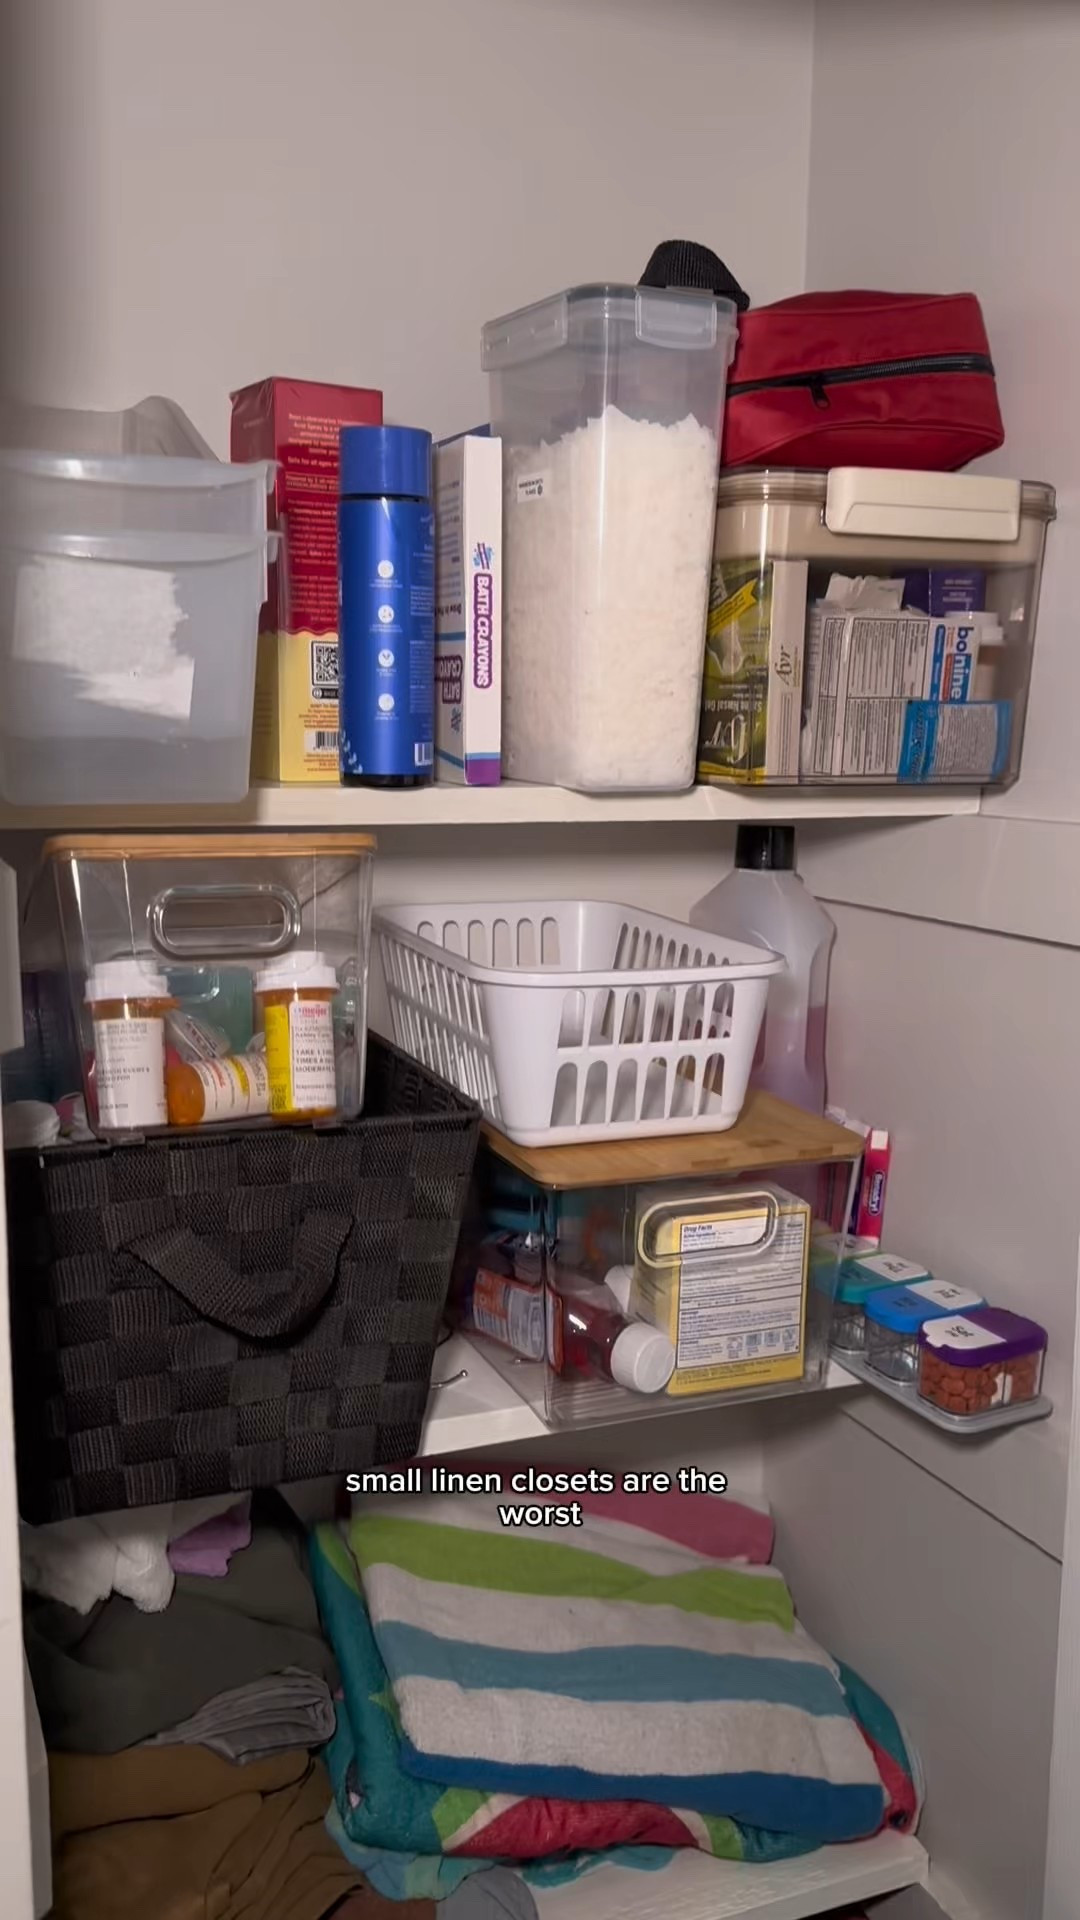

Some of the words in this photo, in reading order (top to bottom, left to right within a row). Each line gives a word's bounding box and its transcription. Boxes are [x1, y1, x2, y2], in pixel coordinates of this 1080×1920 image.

[476, 575, 490, 615] BATH
[475, 616, 489, 687] CRAYONS
[951, 626, 974, 700] bonine
[704, 699, 716, 712] Gel
[716, 700, 739, 712] Nasal
